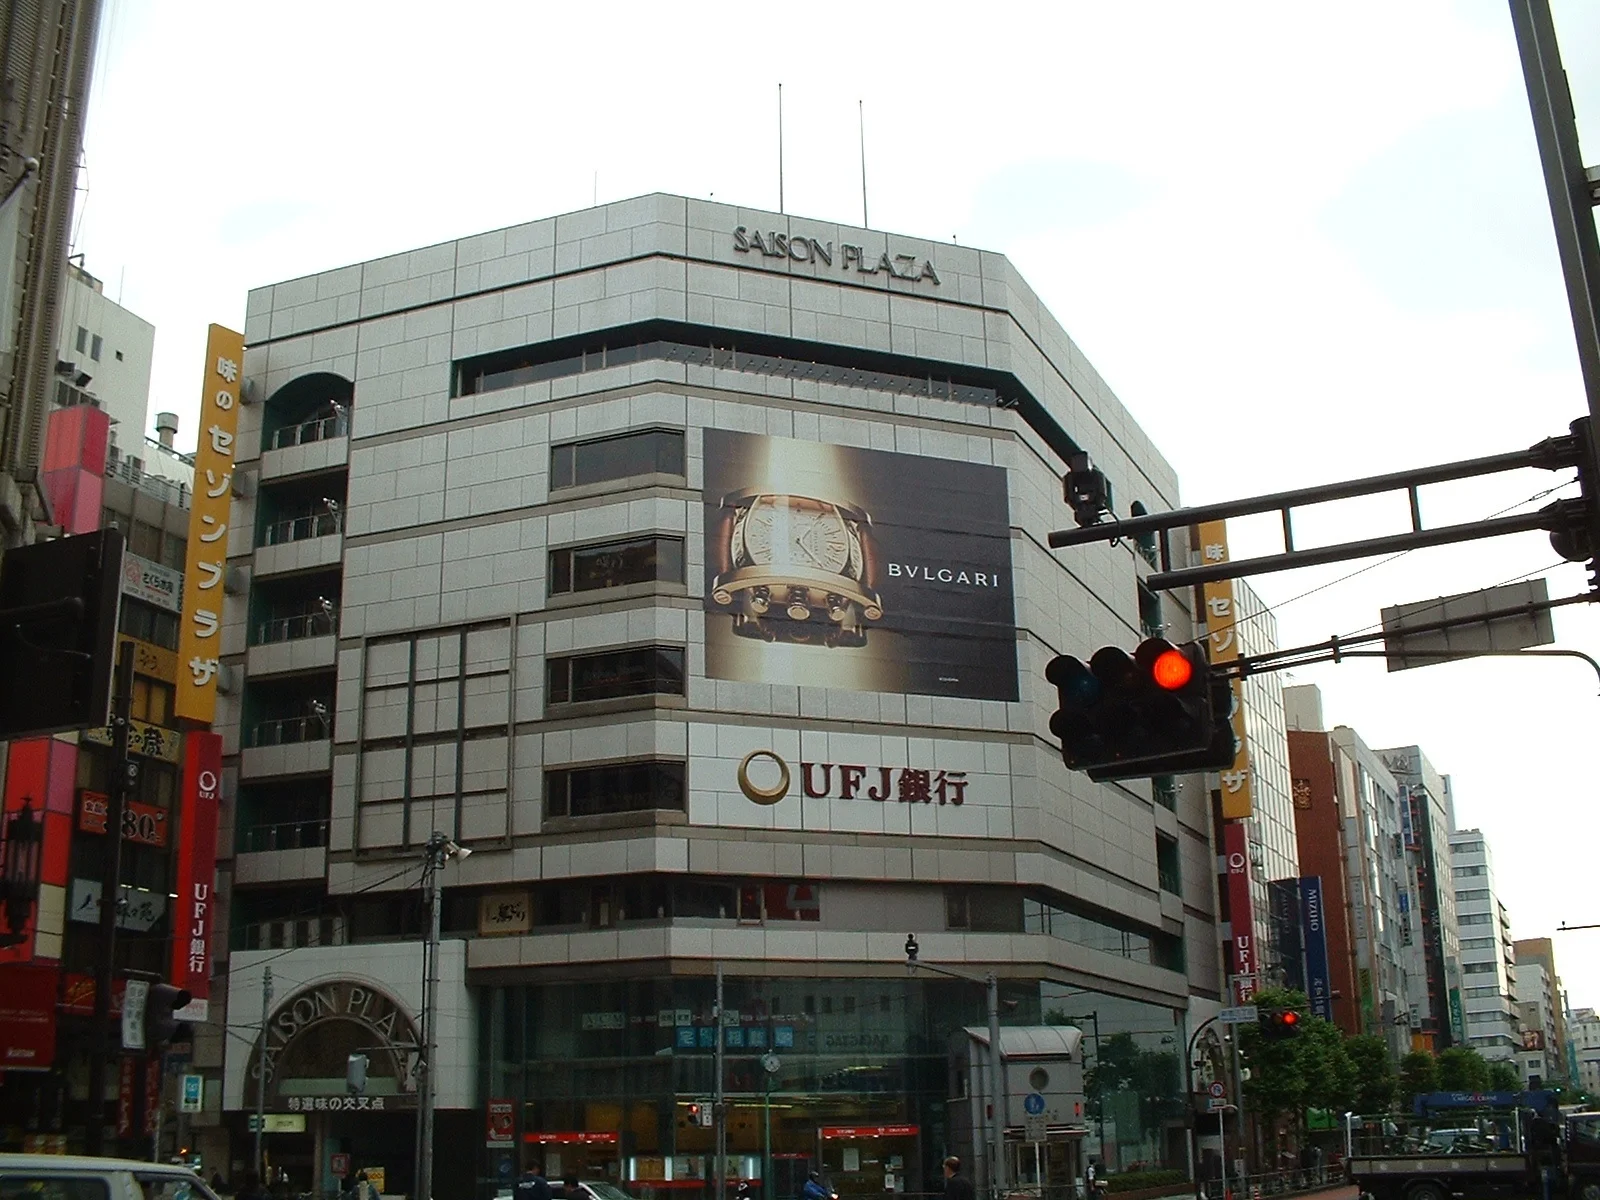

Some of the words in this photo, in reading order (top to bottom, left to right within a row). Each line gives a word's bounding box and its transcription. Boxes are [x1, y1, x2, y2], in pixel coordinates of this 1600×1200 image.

[733, 226, 833, 267] SAISON
[841, 244, 941, 286] PLAZA
[189, 356, 238, 687] 味のセゾンプラザ
[888, 563, 999, 588] BVLGARI
[801, 762, 969, 806] UFJ銀行
[189, 883, 208, 973] UFJ銀行
[1308, 889, 1319, 932] MIZUHO
[252, 986, 339, 1084] SAISON
